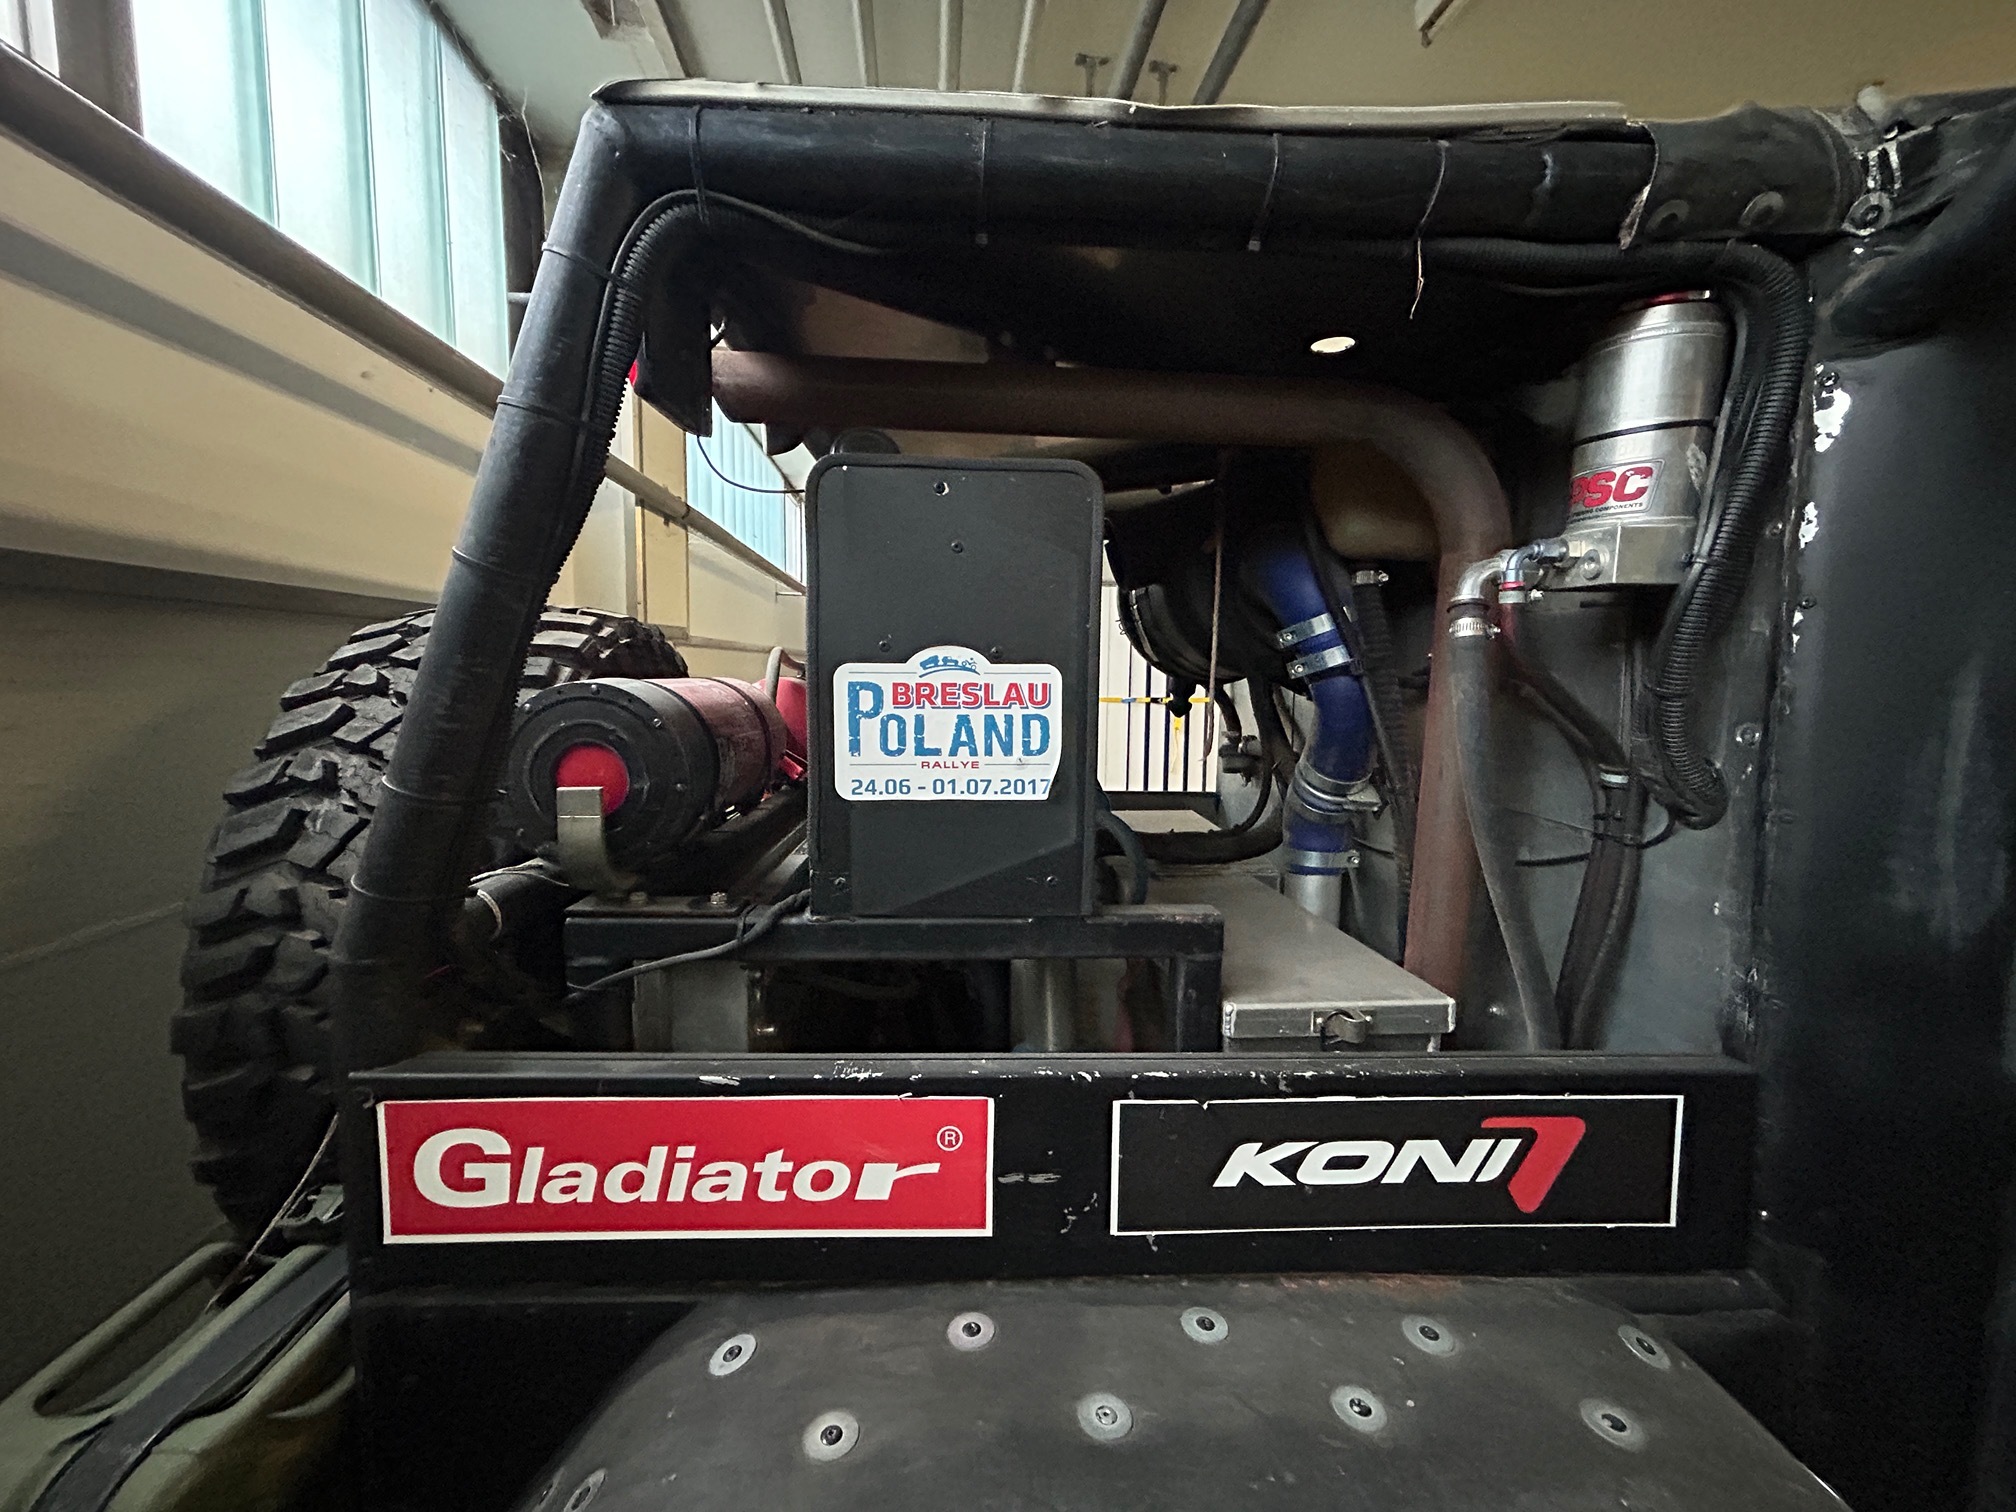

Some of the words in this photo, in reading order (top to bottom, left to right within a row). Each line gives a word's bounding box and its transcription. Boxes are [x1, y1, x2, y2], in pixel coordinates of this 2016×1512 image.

[892, 682, 1051, 709] BRESLAU
[848, 681, 1050, 757] POLAND
[921, 760, 980, 769] RALLYE
[851, 779, 911, 795] 24.06
[932, 778, 1052, 795] 01.07.2017
[413, 1127, 940, 1208] Gladiator
